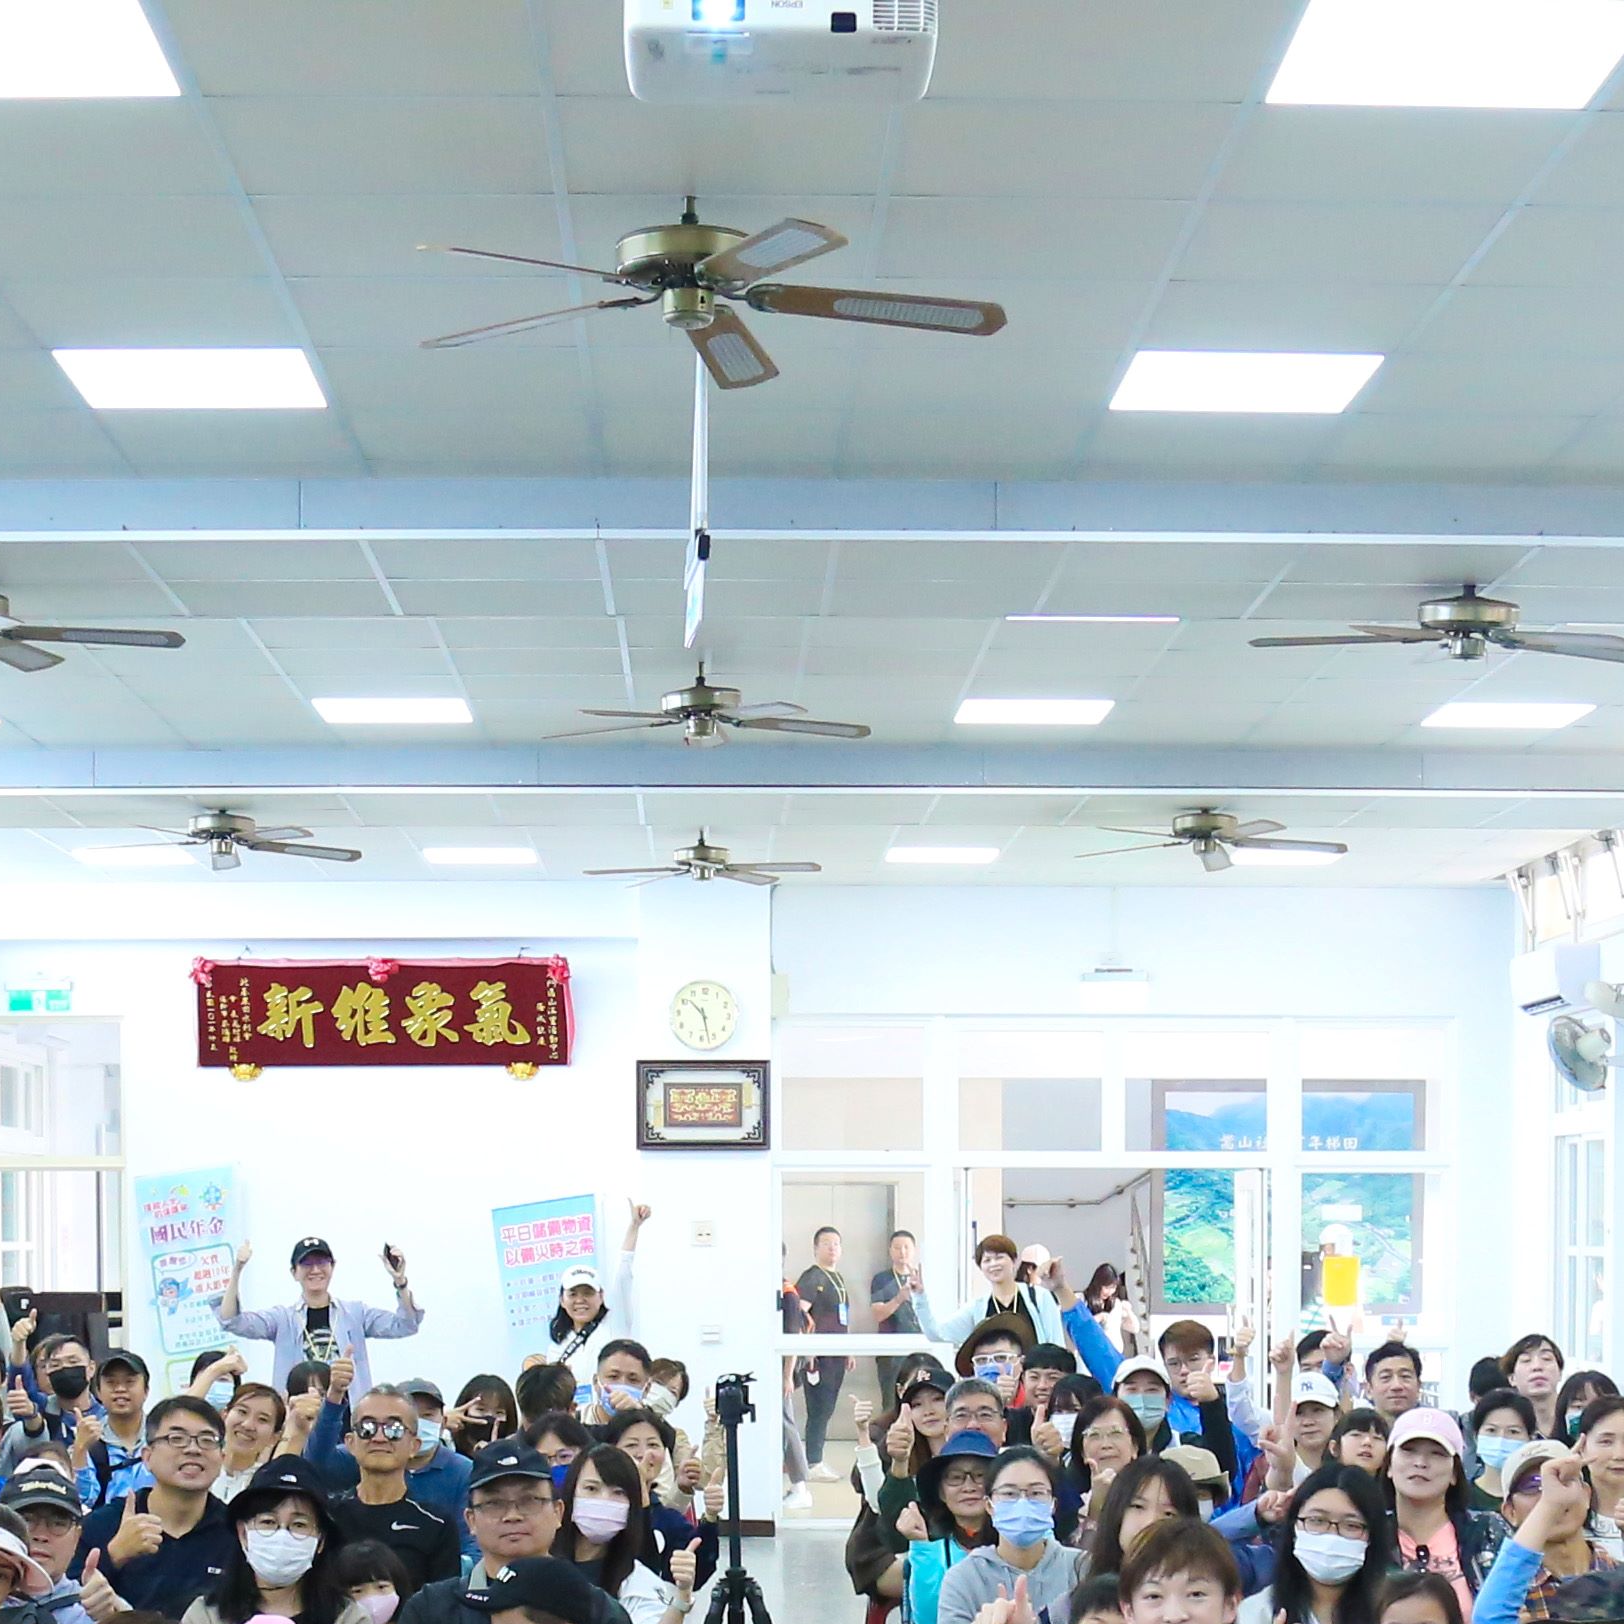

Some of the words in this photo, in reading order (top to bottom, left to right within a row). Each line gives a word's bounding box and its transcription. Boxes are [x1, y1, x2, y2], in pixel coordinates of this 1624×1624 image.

[150, 1216, 225, 1245] 國民年金
[501, 1216, 592, 1242] 平日儲備物資
